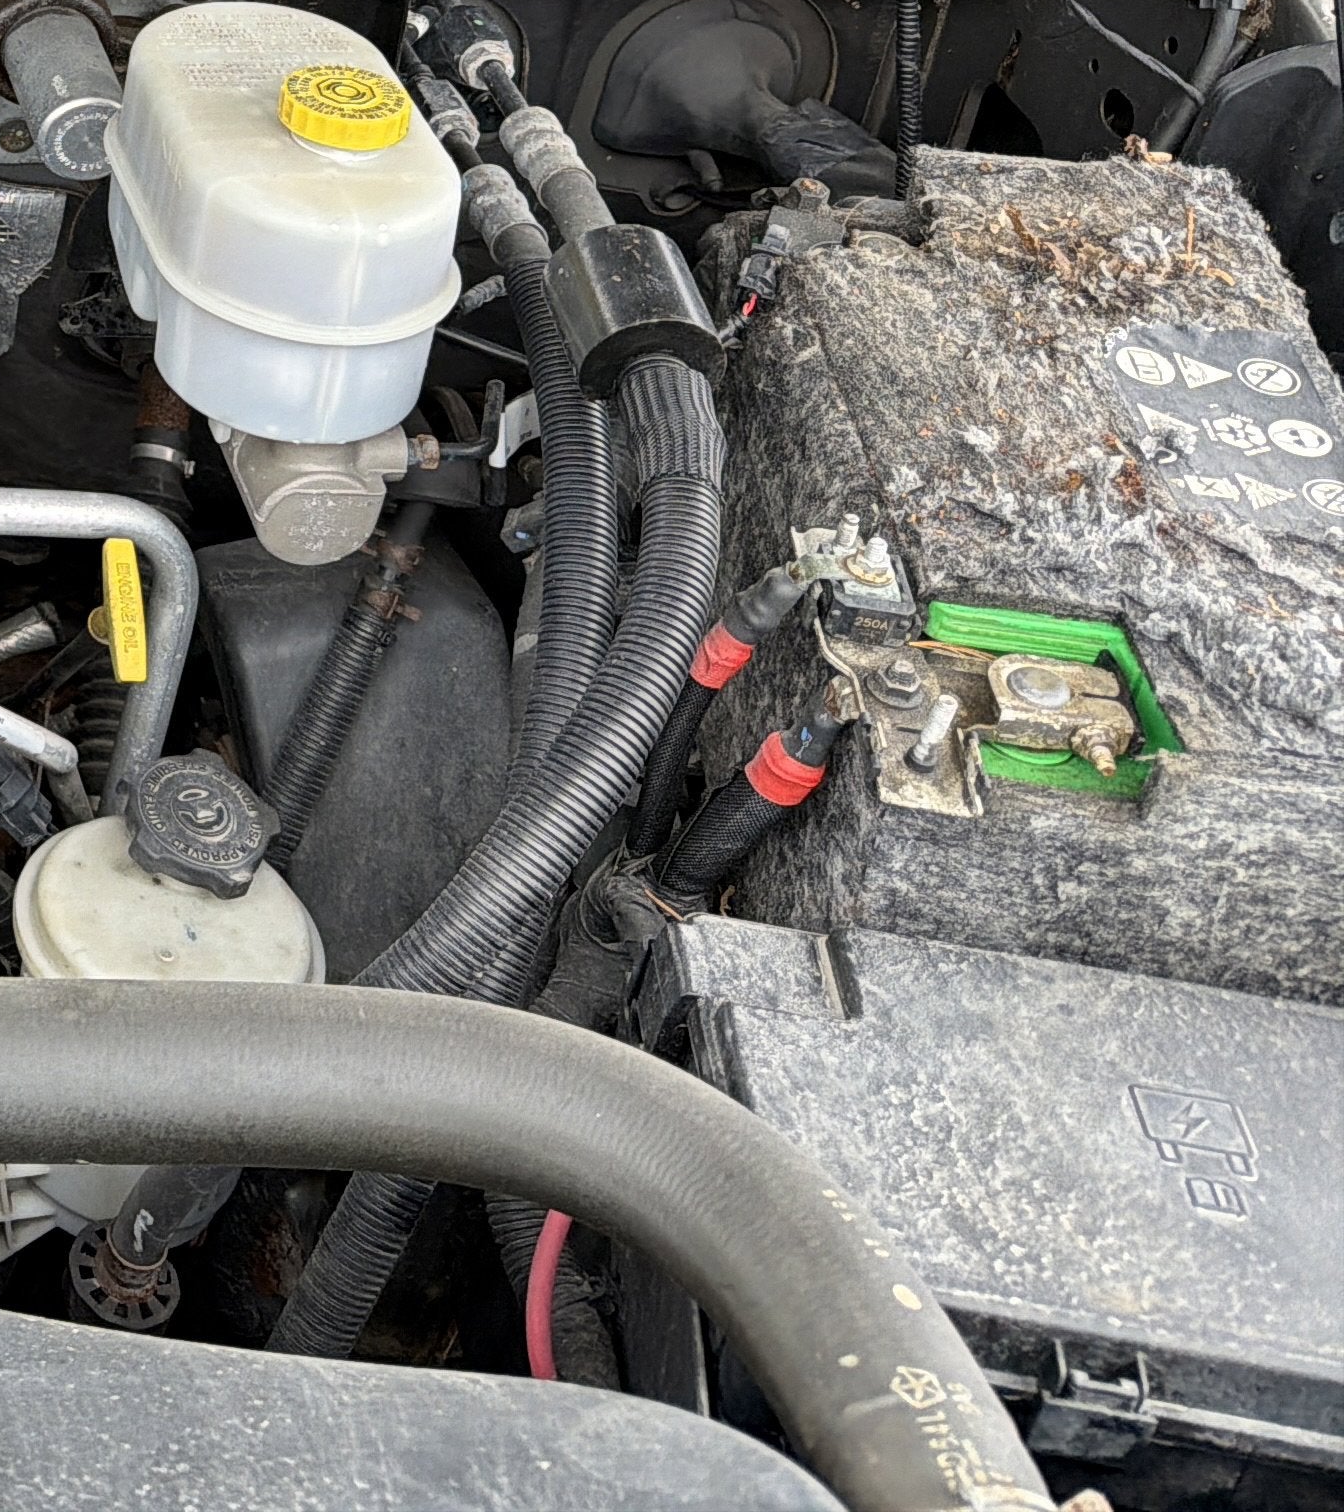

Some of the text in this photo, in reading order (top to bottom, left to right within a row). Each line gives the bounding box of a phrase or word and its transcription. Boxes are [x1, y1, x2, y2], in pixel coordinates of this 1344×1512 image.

[115, 562, 139, 654] ENGINE OIL
[853, 616, 889, 631] 250A
[170, 823, 262, 862] USE APPROVED
